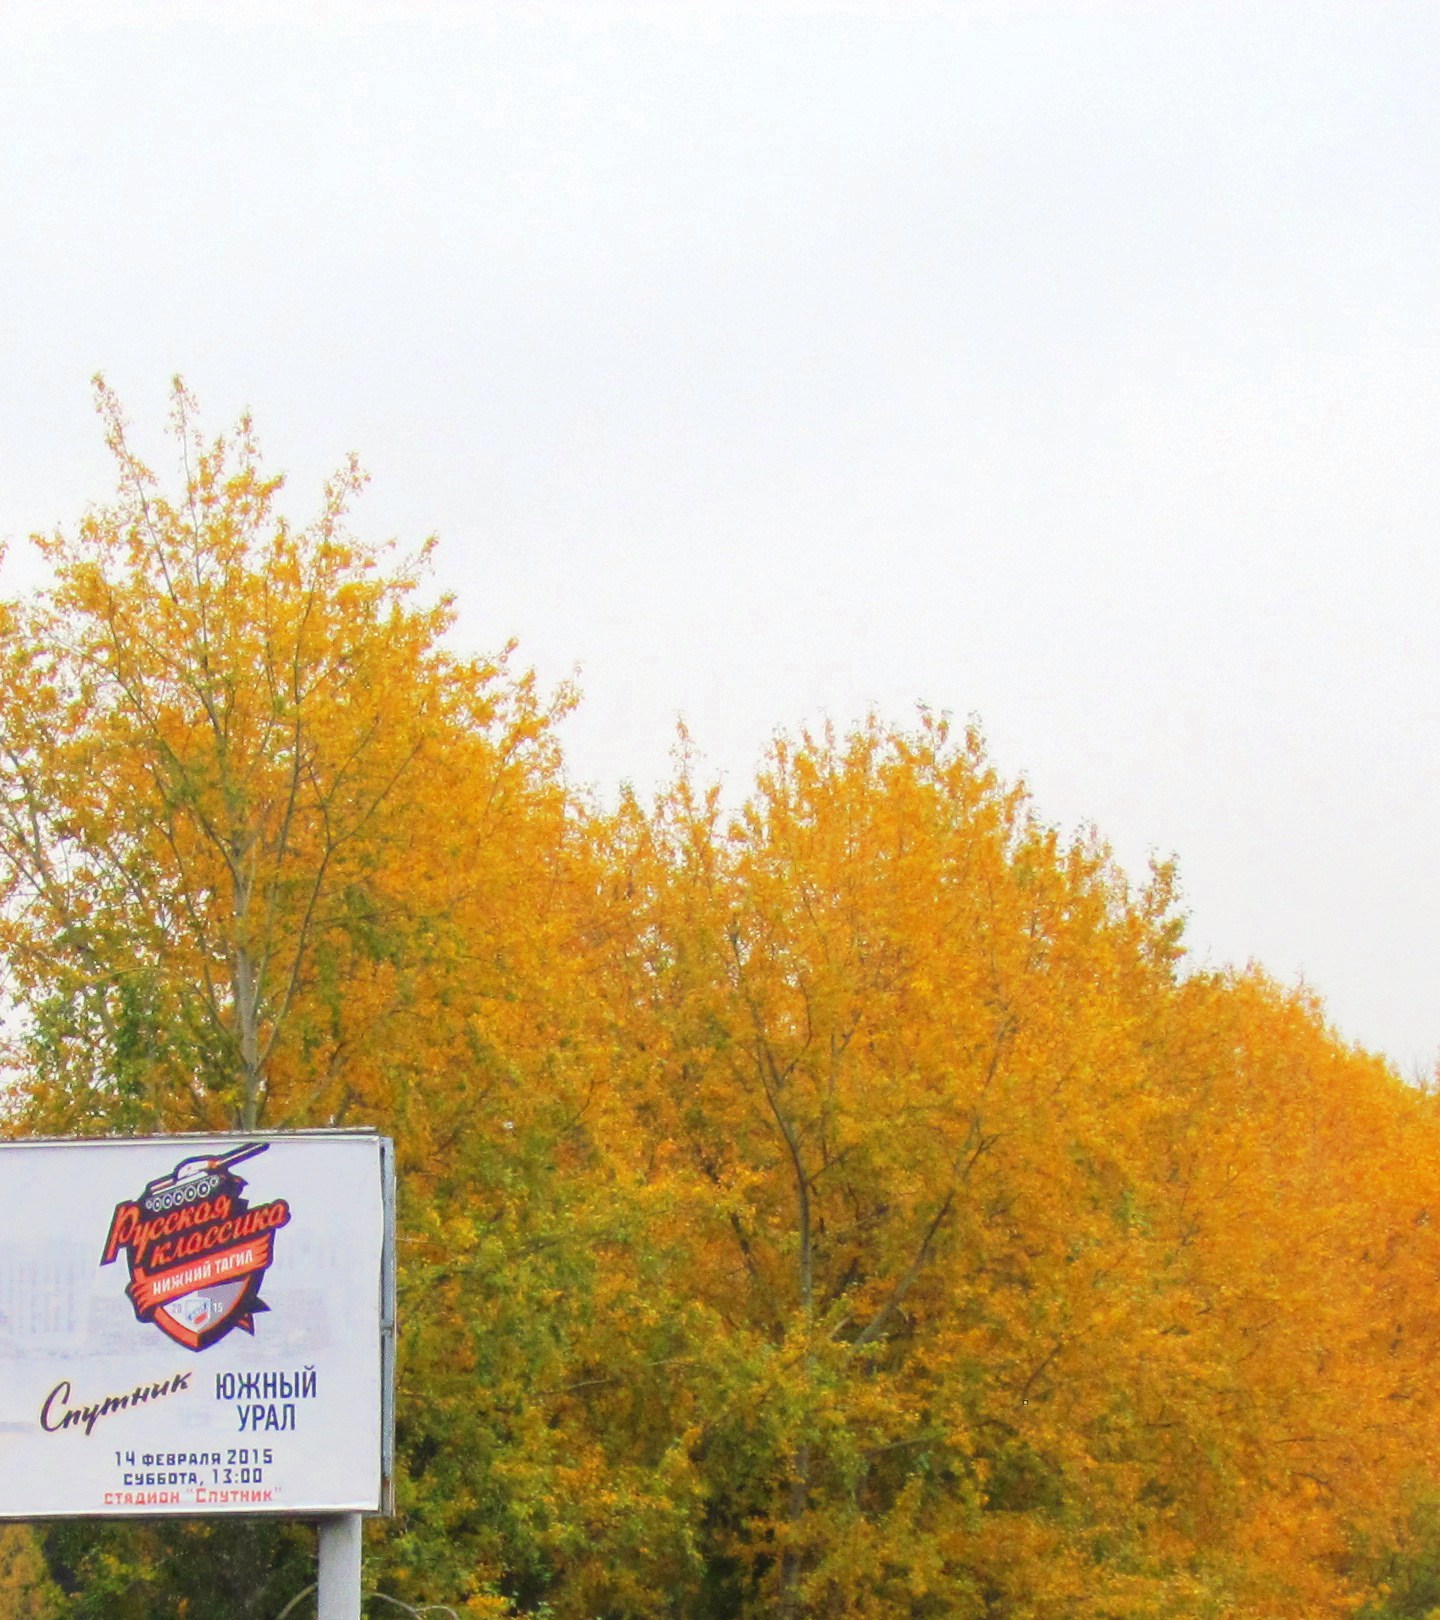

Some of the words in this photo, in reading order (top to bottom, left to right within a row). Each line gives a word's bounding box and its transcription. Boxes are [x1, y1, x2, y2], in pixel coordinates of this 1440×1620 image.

[105, 1194, 232, 1265] Русская
[150, 1201, 288, 1269] классика
[152, 1260, 211, 1295] НИЖНИЙ
[214, 1249, 254, 1274] ТАГИЛ
[215, 1364, 317, 1400] ЮЖНЫЙ
[40, 1371, 193, 1437] Спутник
[236, 1403, 296, 1432] УРАЛ
[114, 1450, 136, 1467] 14
[141, 1452, 221, 1467] ФЕВРАЛЯ
[227, 1448, 274, 1465] 2015
[123, 1472, 205, 1487] СУББОТА,
[212, 1468, 263, 1485] 13:00
[103, 1491, 181, 1506] СТАДИОН
